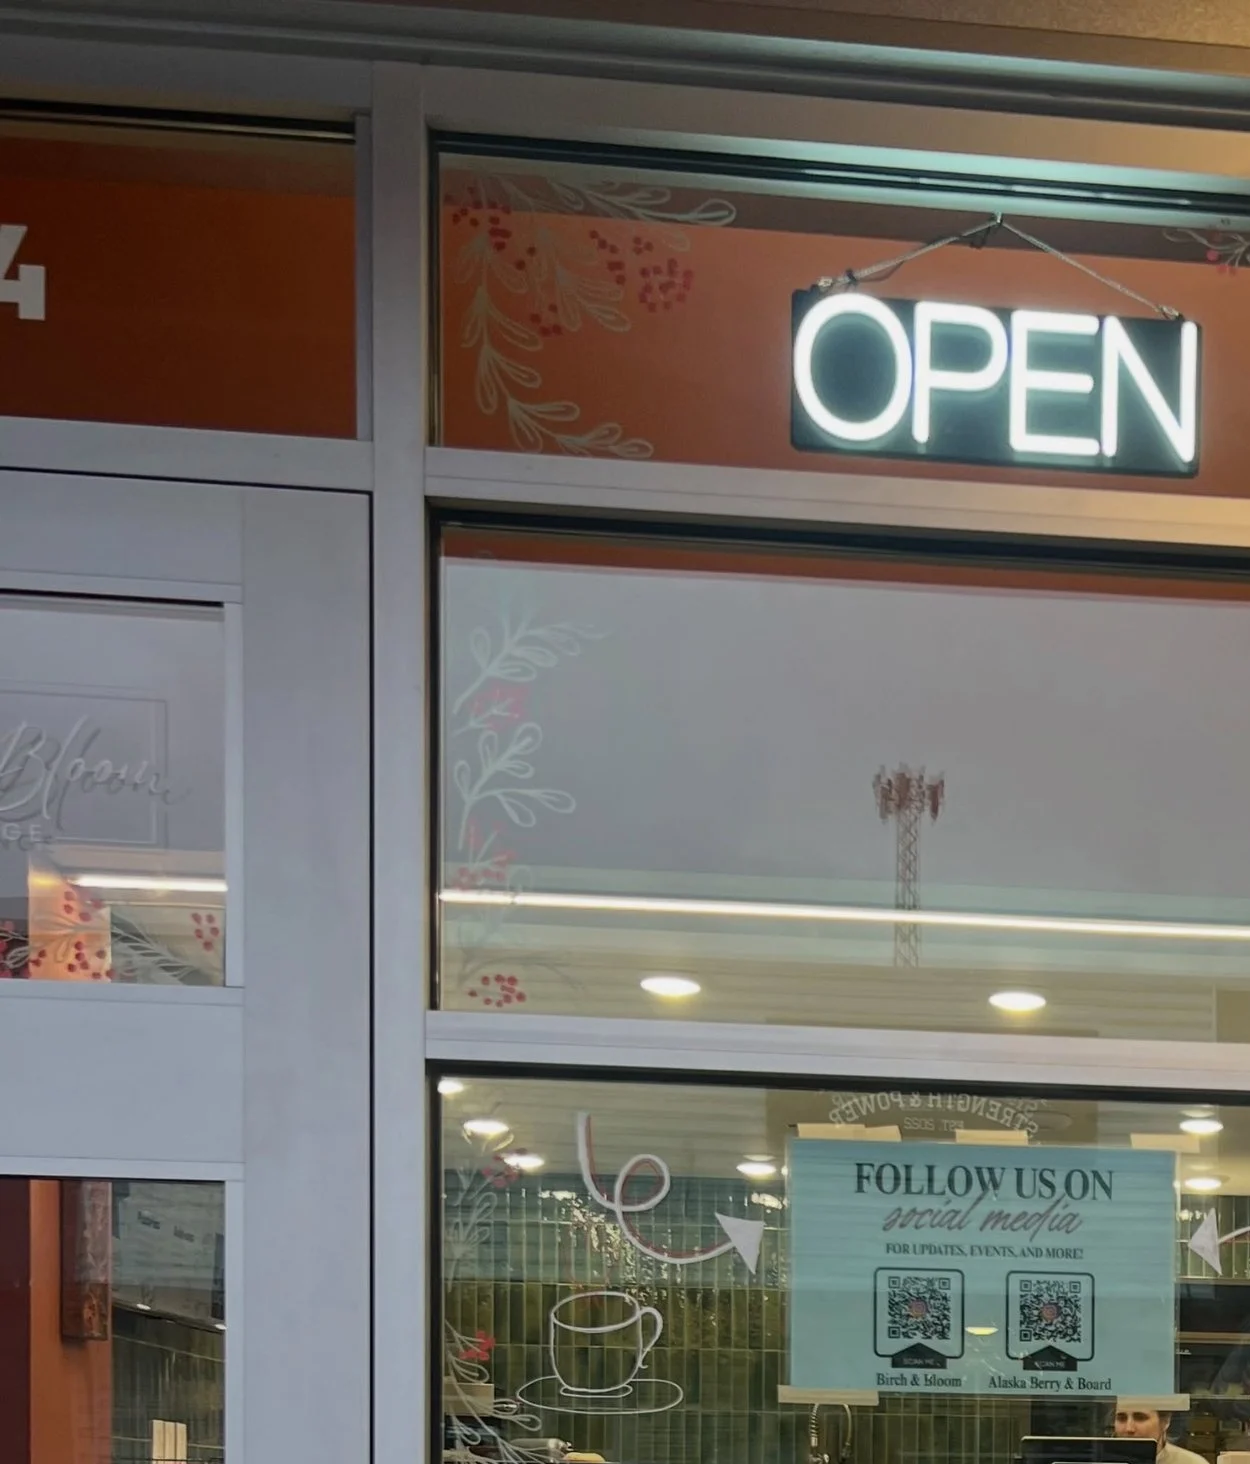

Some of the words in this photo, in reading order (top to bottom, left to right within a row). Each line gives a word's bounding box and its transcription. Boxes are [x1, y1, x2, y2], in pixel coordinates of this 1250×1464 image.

[793, 292, 1198, 463] OPEN
[854, 1161, 1006, 1199] FOLLOW
[1013, 1167, 1057, 1200] US
[1064, 1168, 1115, 1201] ON
[882, 1190, 989, 1232] social
[979, 1192, 1084, 1242] media
[885, 1243, 910, 1254] FOR
[912, 1244, 968, 1257] UPDATES,
[1019, 1247, 1043, 1259] AND
[1044, 1248, 1084, 1260] MORE!
[876, 1372, 907, 1386] Birch
[910, 1374, 920, 1386] &
[923, 1374, 962, 1387] Bloom
[988, 1376, 1027, 1389] Alaska
[1029, 1377, 1061, 1391] Berry
[1063, 1378, 1074, 1390] &
[1077, 1378, 1112, 1390] Board
